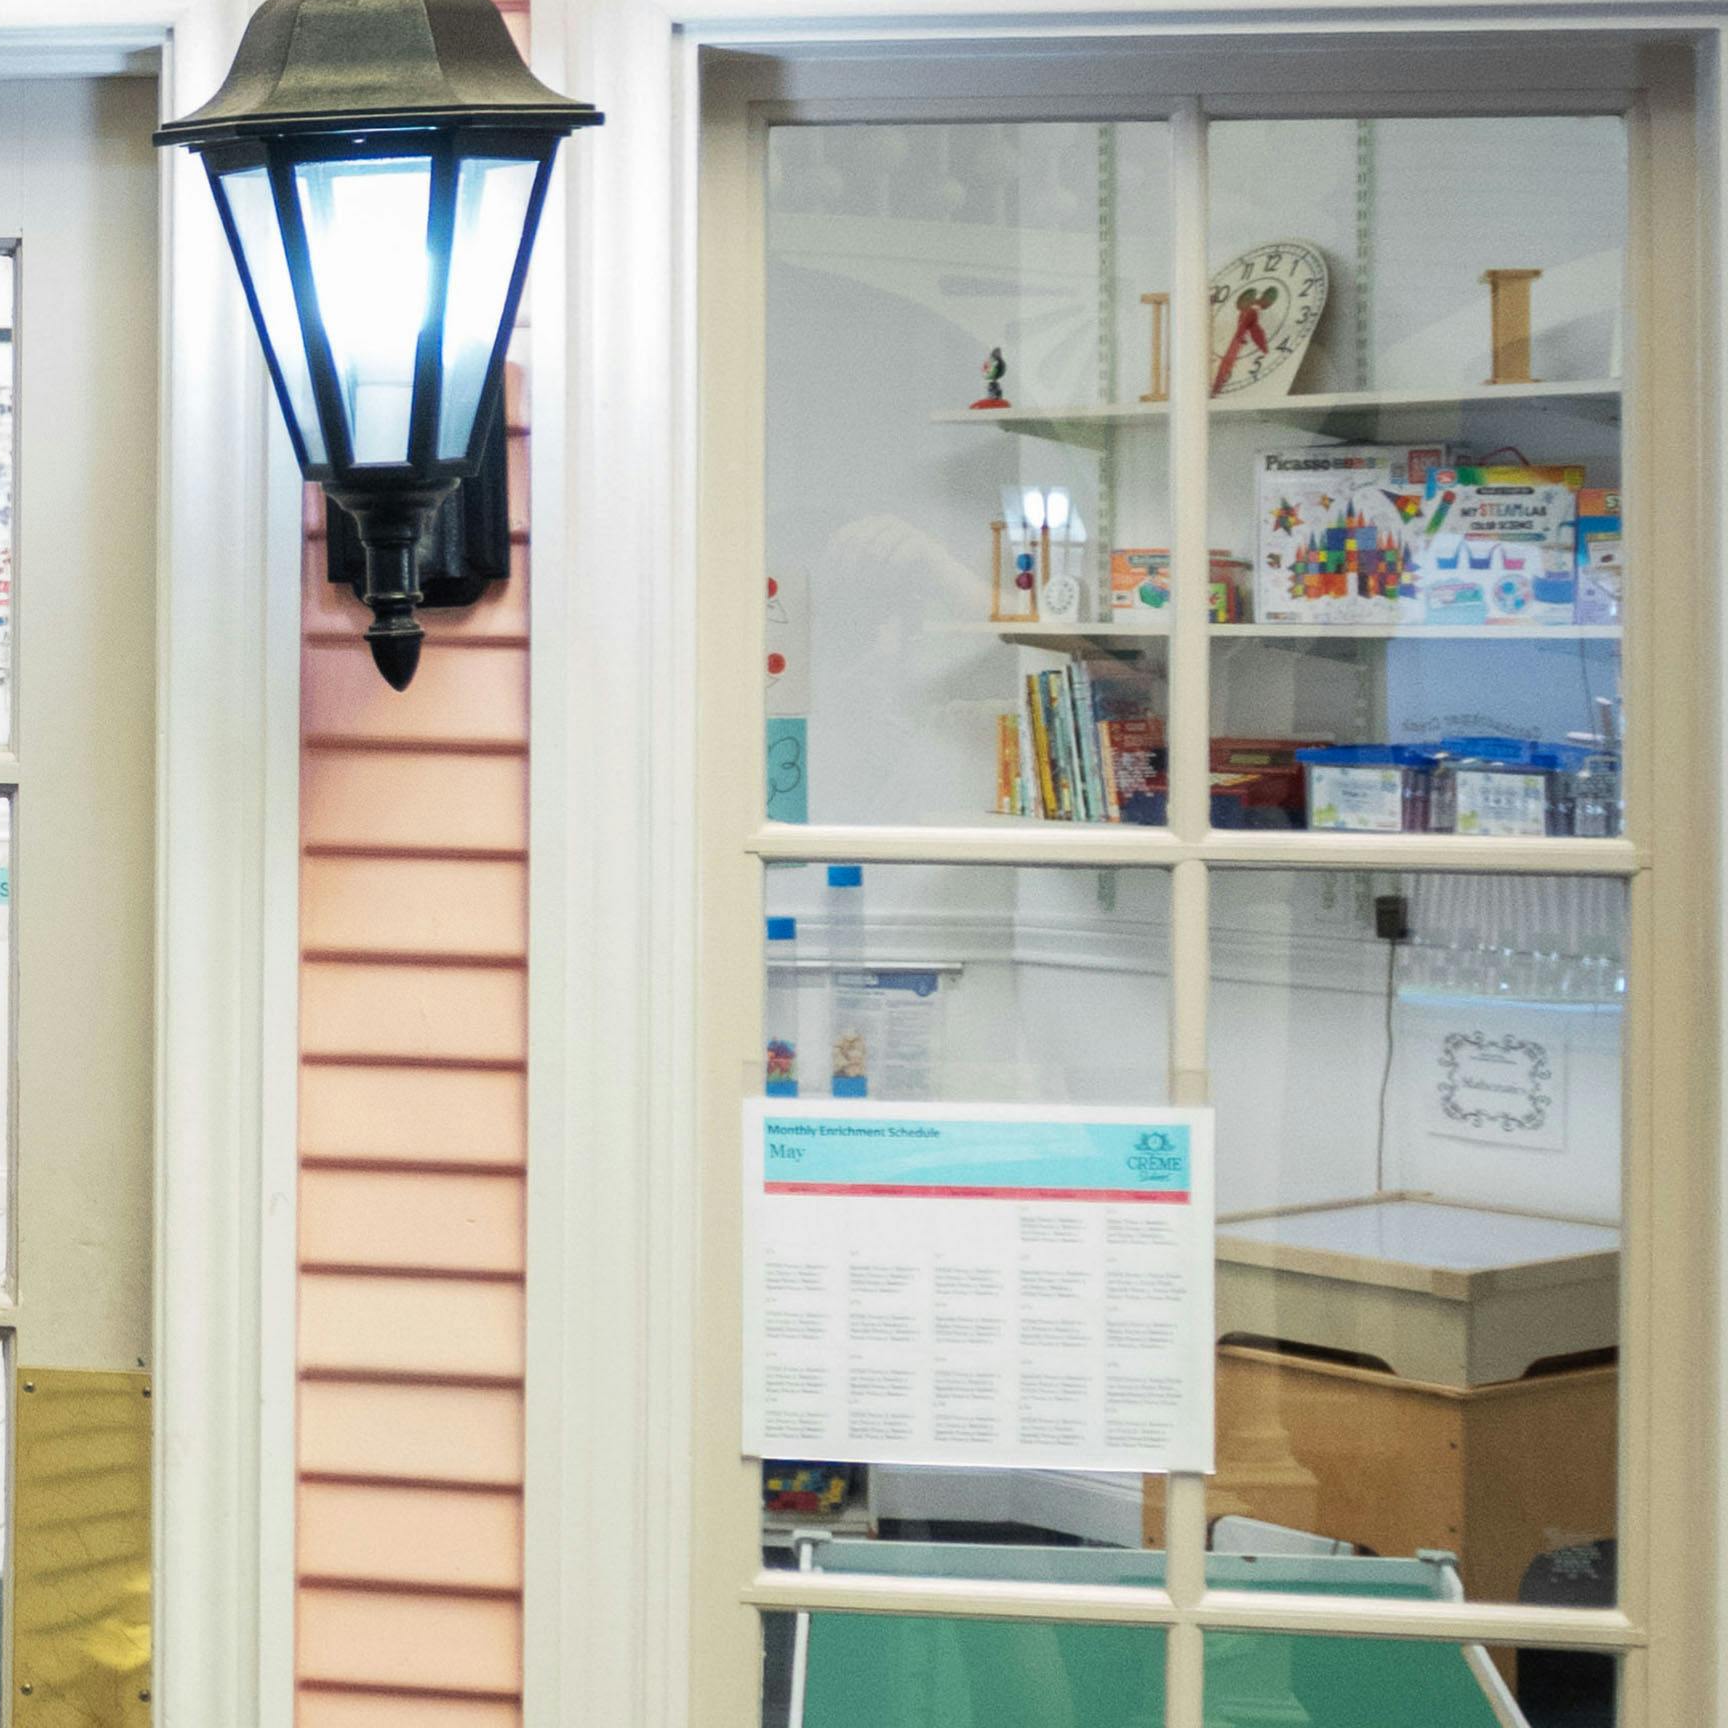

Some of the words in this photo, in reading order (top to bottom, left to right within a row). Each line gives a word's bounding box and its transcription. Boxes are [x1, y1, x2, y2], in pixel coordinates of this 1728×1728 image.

[1264, 254, 1283, 272] 12
[1298, 278, 1314, 297] 2
[1296, 305, 1311, 324] 3
[1265, 454, 1331, 471] Picasso
[767, 1124, 816, 1138] Monthly
[820, 1125, 885, 1138] Enrichment
[888, 1127, 940, 1139] Schedule
[769, 1143, 806, 1162] May
